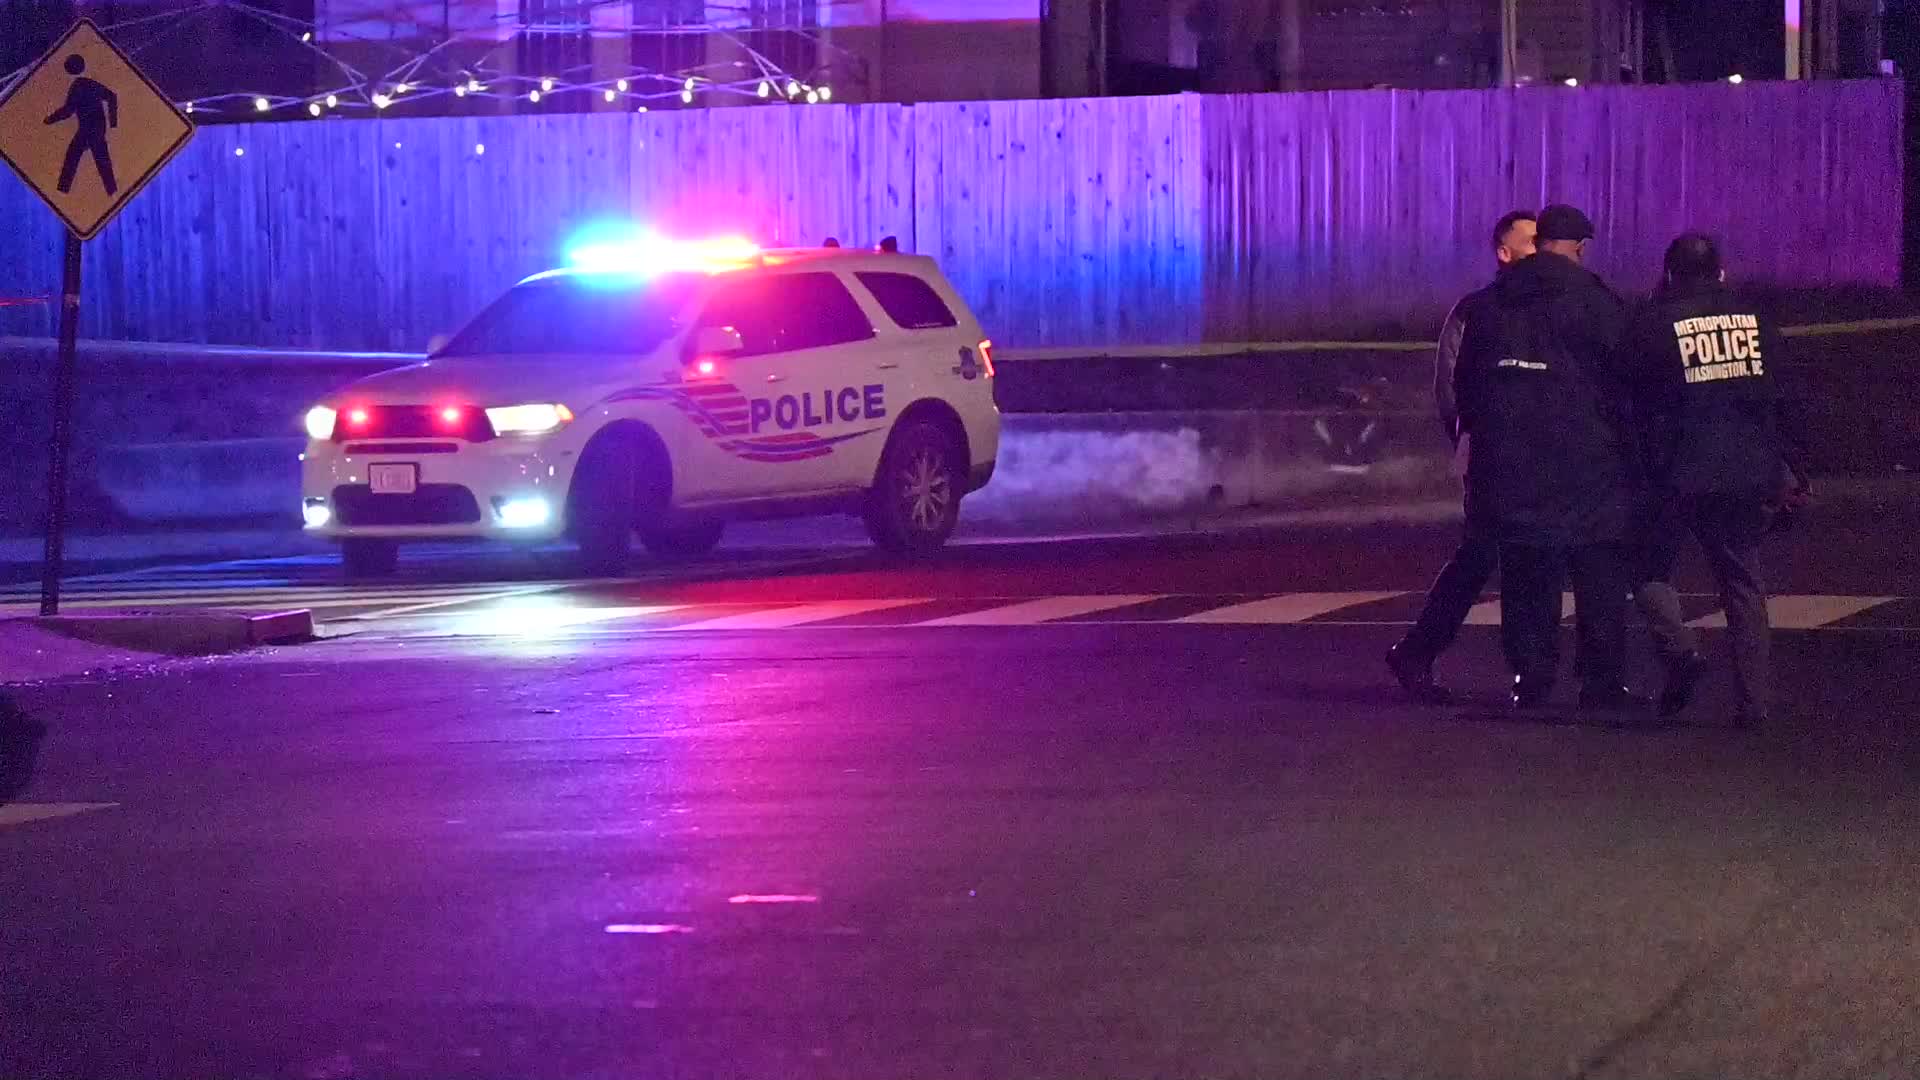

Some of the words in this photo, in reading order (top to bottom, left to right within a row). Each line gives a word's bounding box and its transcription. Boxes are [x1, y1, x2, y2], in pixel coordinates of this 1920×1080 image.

[1673, 314, 1758, 337] METROPOLITAN
[1678, 329, 1762, 368] POLICE
[751, 384, 886, 433] POLICE
